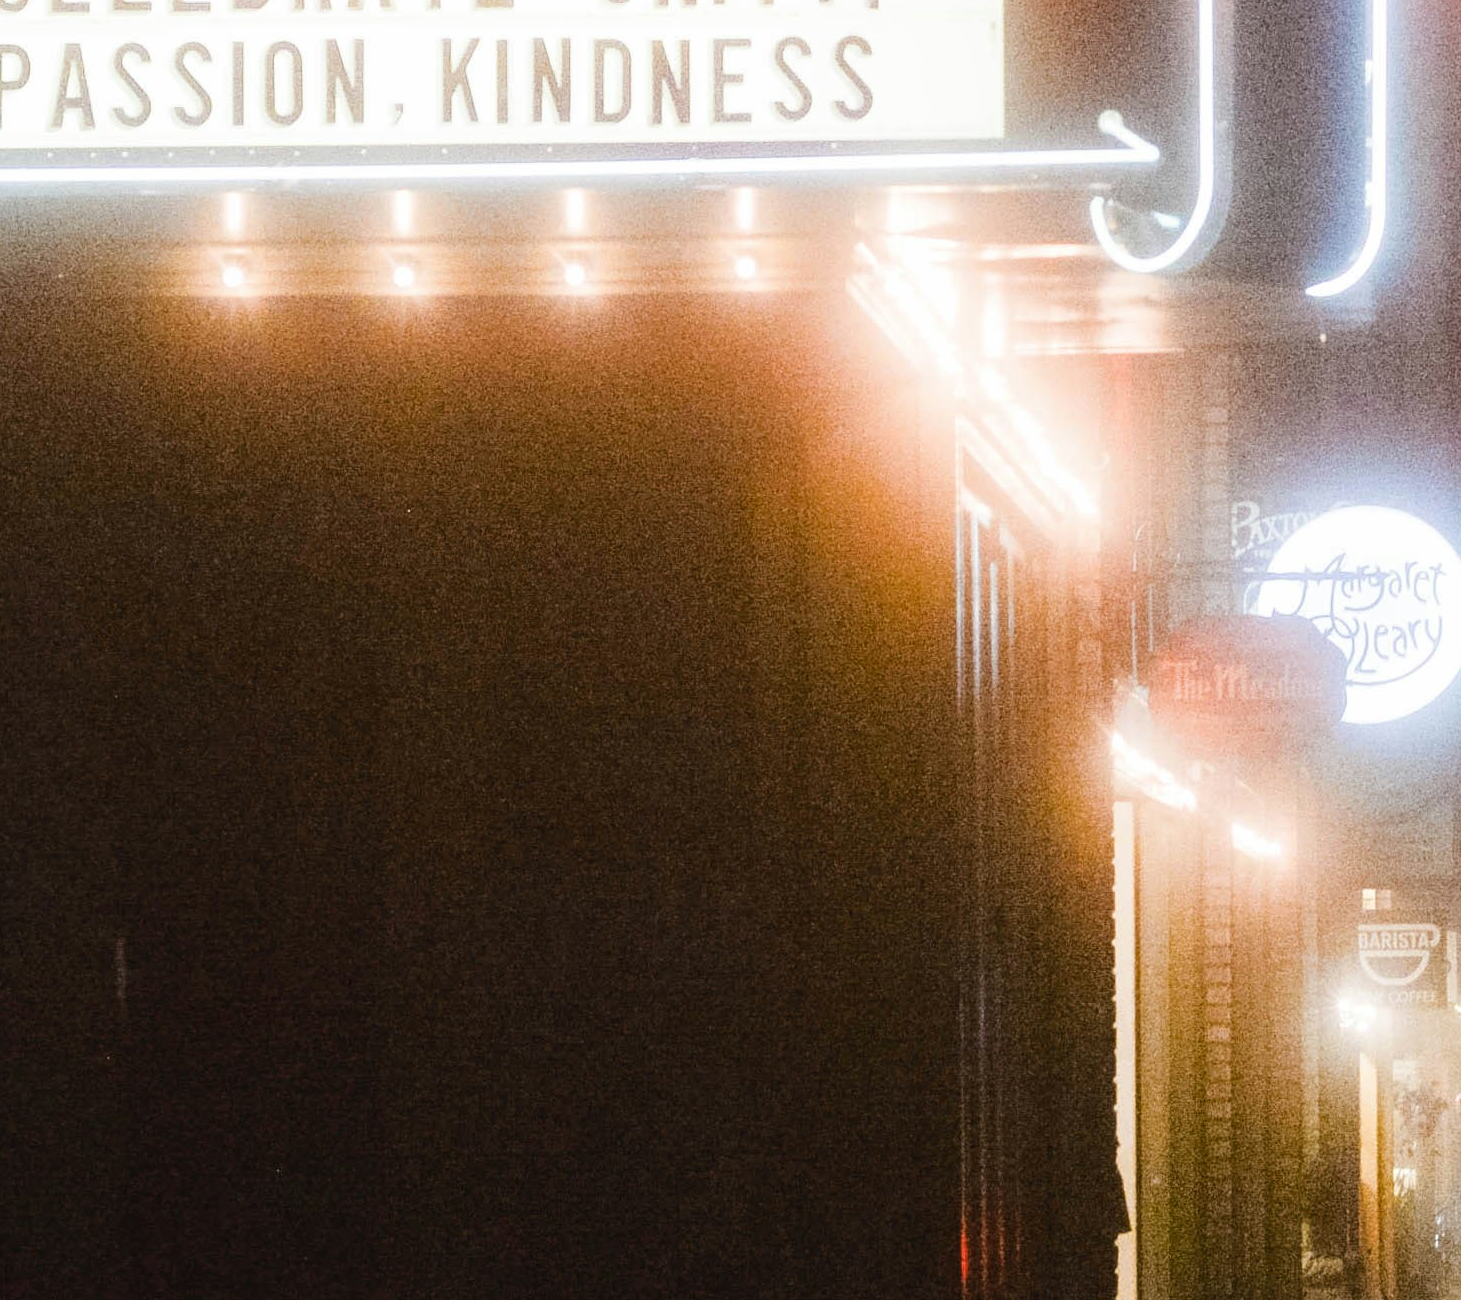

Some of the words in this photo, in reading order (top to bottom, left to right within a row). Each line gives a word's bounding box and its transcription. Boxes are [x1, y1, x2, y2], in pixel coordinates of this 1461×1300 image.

[441, 34, 875, 124] KINDNESS
[1230, 499, 1317, 560] PAXTO
[1280, 552, 1447, 615] Margaret
[1358, 930, 1430, 950] BARISTA
